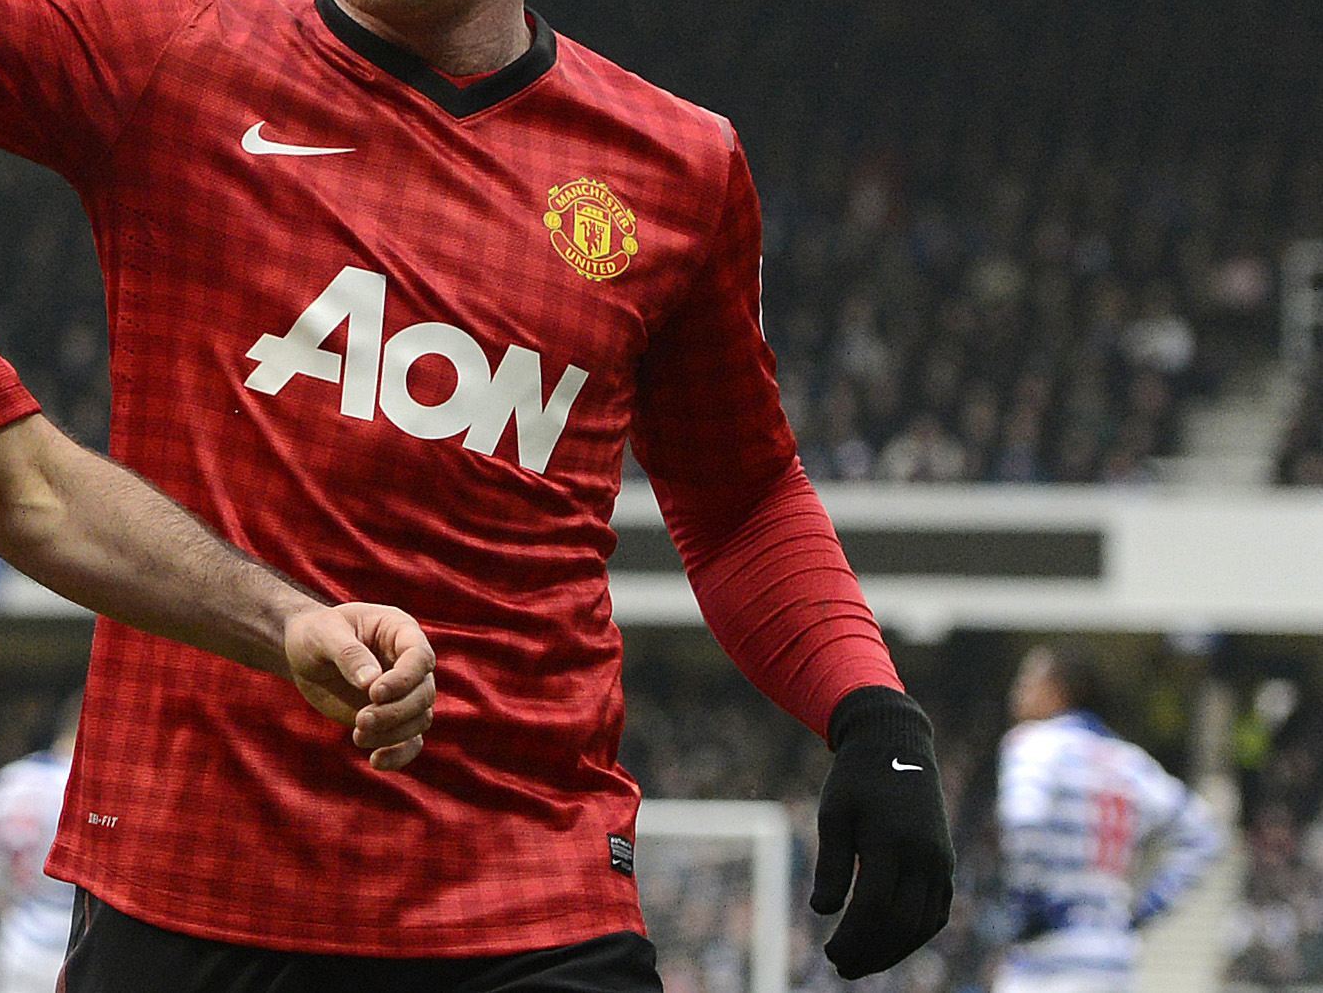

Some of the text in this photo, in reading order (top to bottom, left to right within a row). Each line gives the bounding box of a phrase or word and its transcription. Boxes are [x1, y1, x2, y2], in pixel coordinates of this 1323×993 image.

[555, 185, 630, 229] MANCHESTER
[564, 247, 616, 274] UNITED
[244, 265, 590, 474] AON
